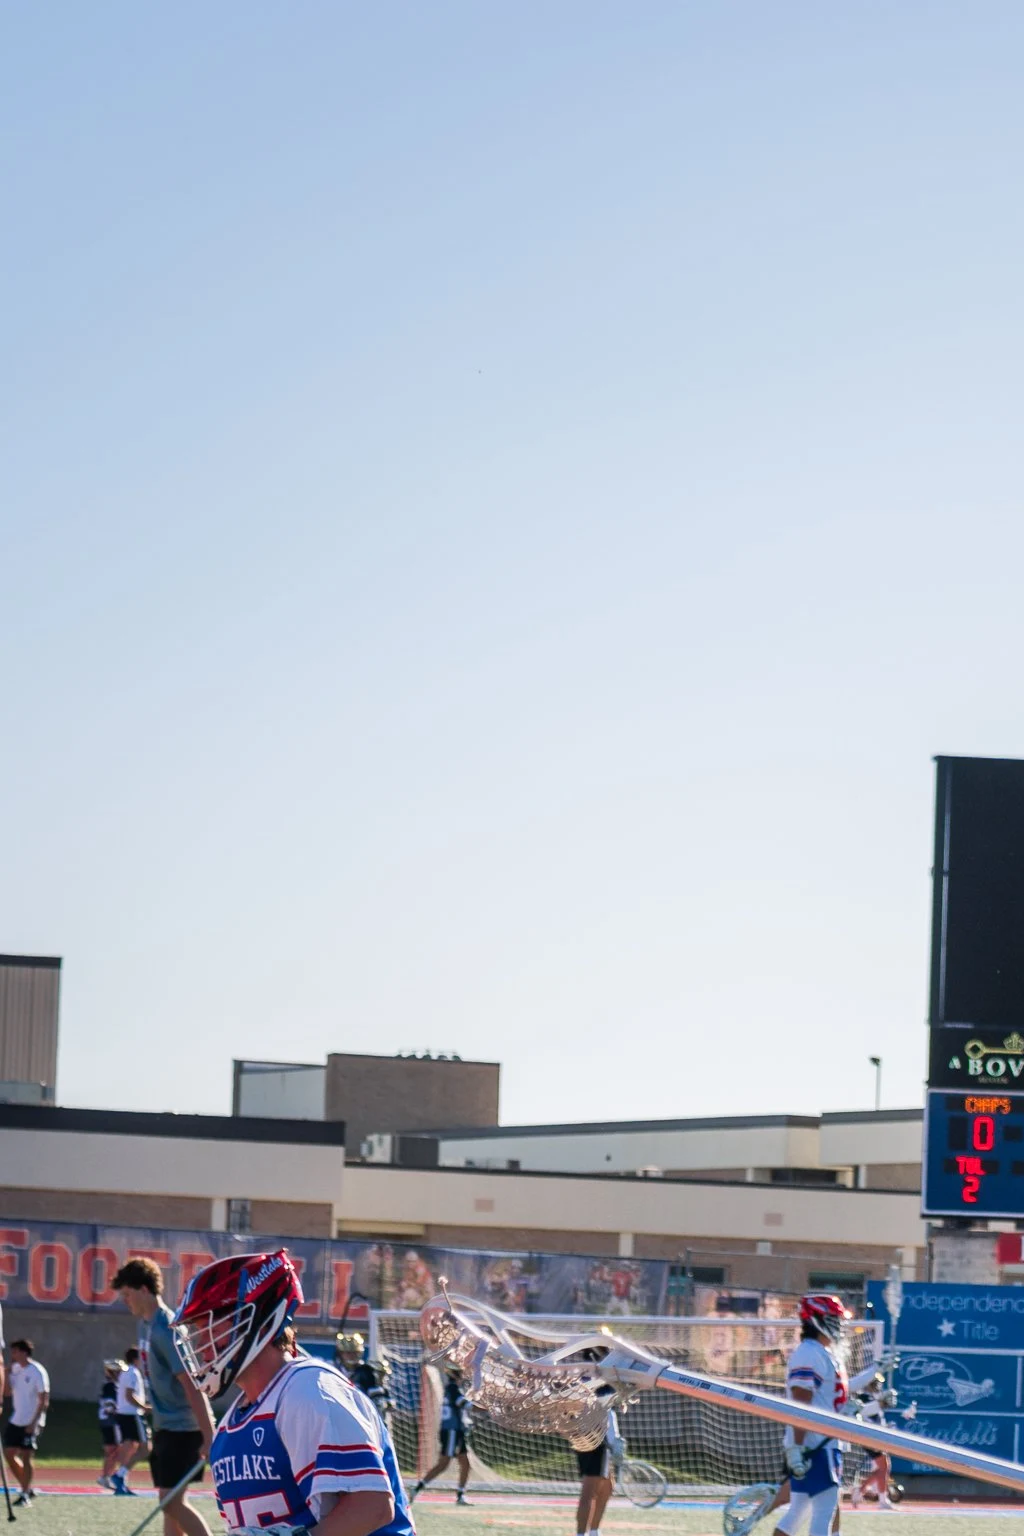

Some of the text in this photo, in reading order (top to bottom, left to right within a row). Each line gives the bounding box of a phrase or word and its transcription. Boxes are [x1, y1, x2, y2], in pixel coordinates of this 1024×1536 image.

[973, 1116, 994, 1151] 0
[962, 1175, 979, 1203] 2
[960, 1320, 999, 1340] Title
